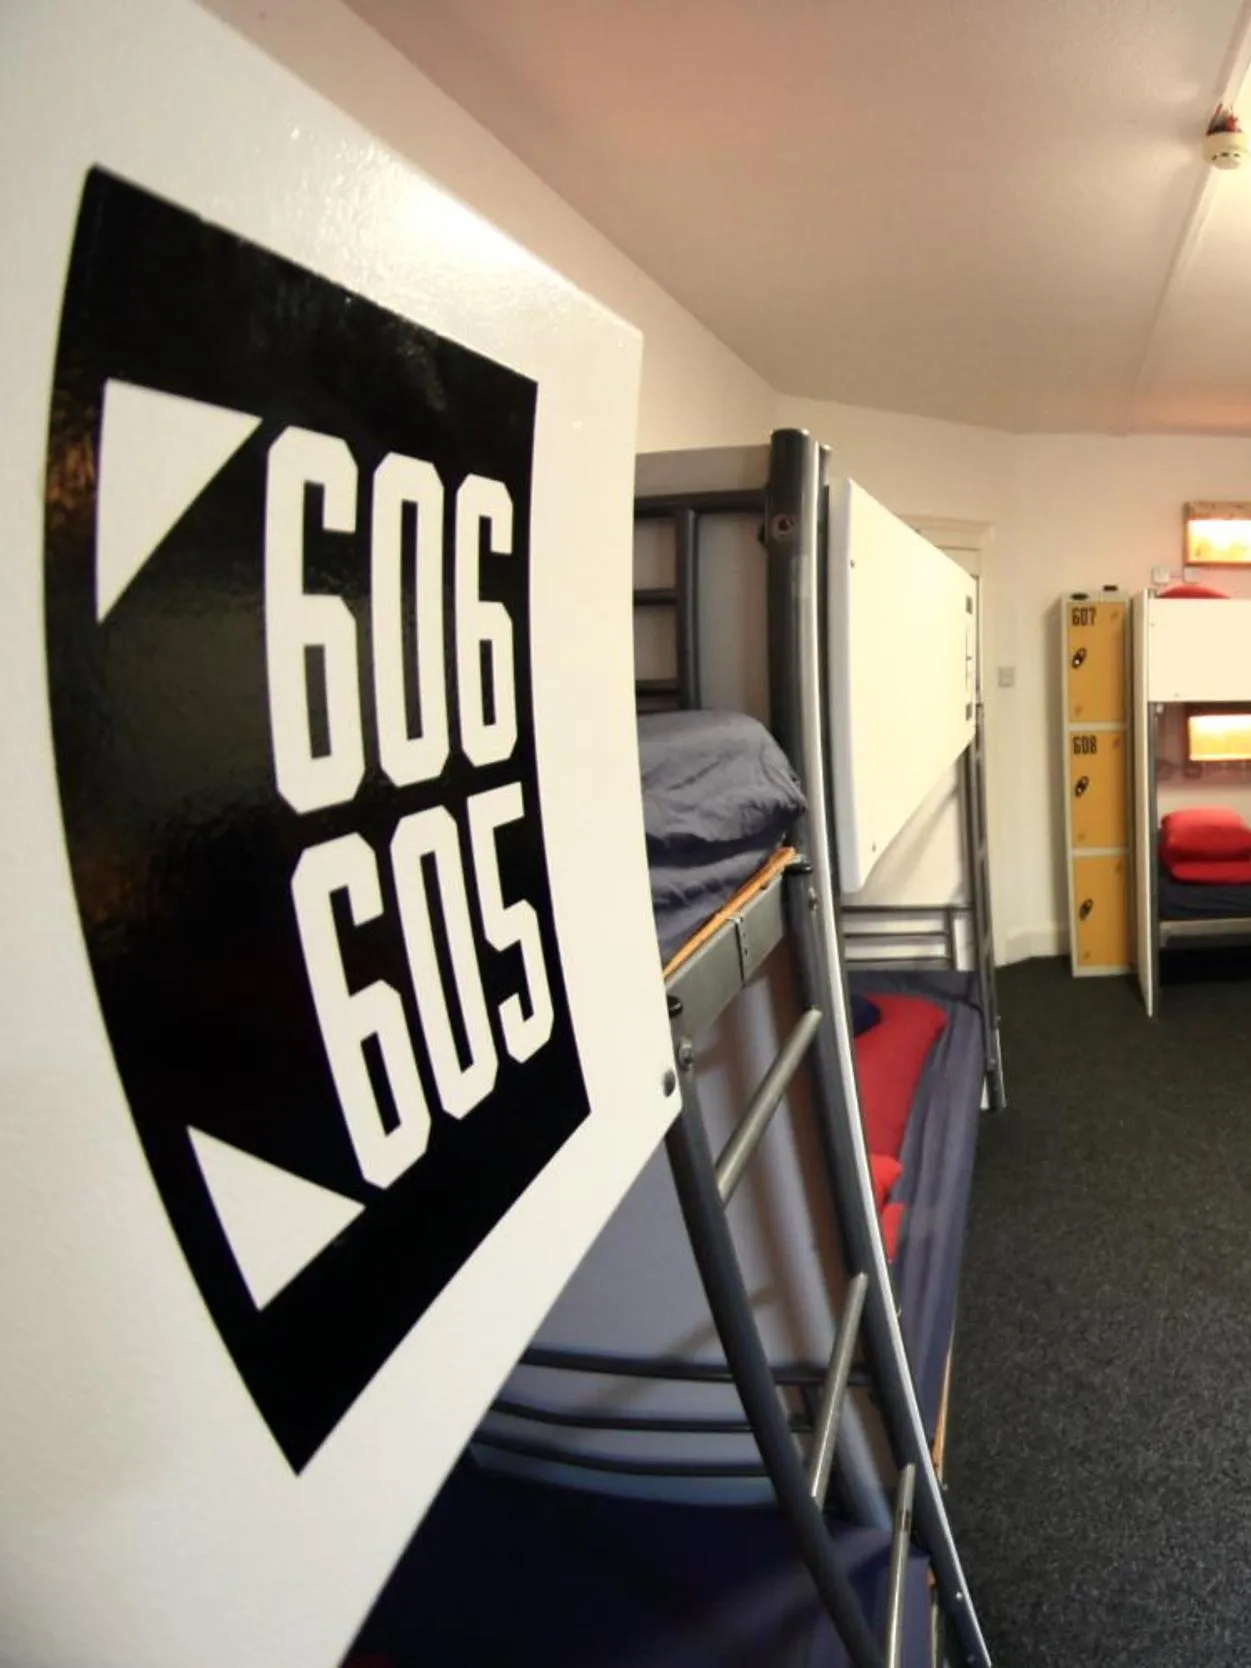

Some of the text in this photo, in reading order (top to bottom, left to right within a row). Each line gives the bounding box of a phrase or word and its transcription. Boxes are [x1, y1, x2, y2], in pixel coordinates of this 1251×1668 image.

[263, 426, 518, 814] 606
[1071, 606, 1097, 626] 607
[1072, 735, 1097, 755] 608
[291, 782, 554, 1189] 605
